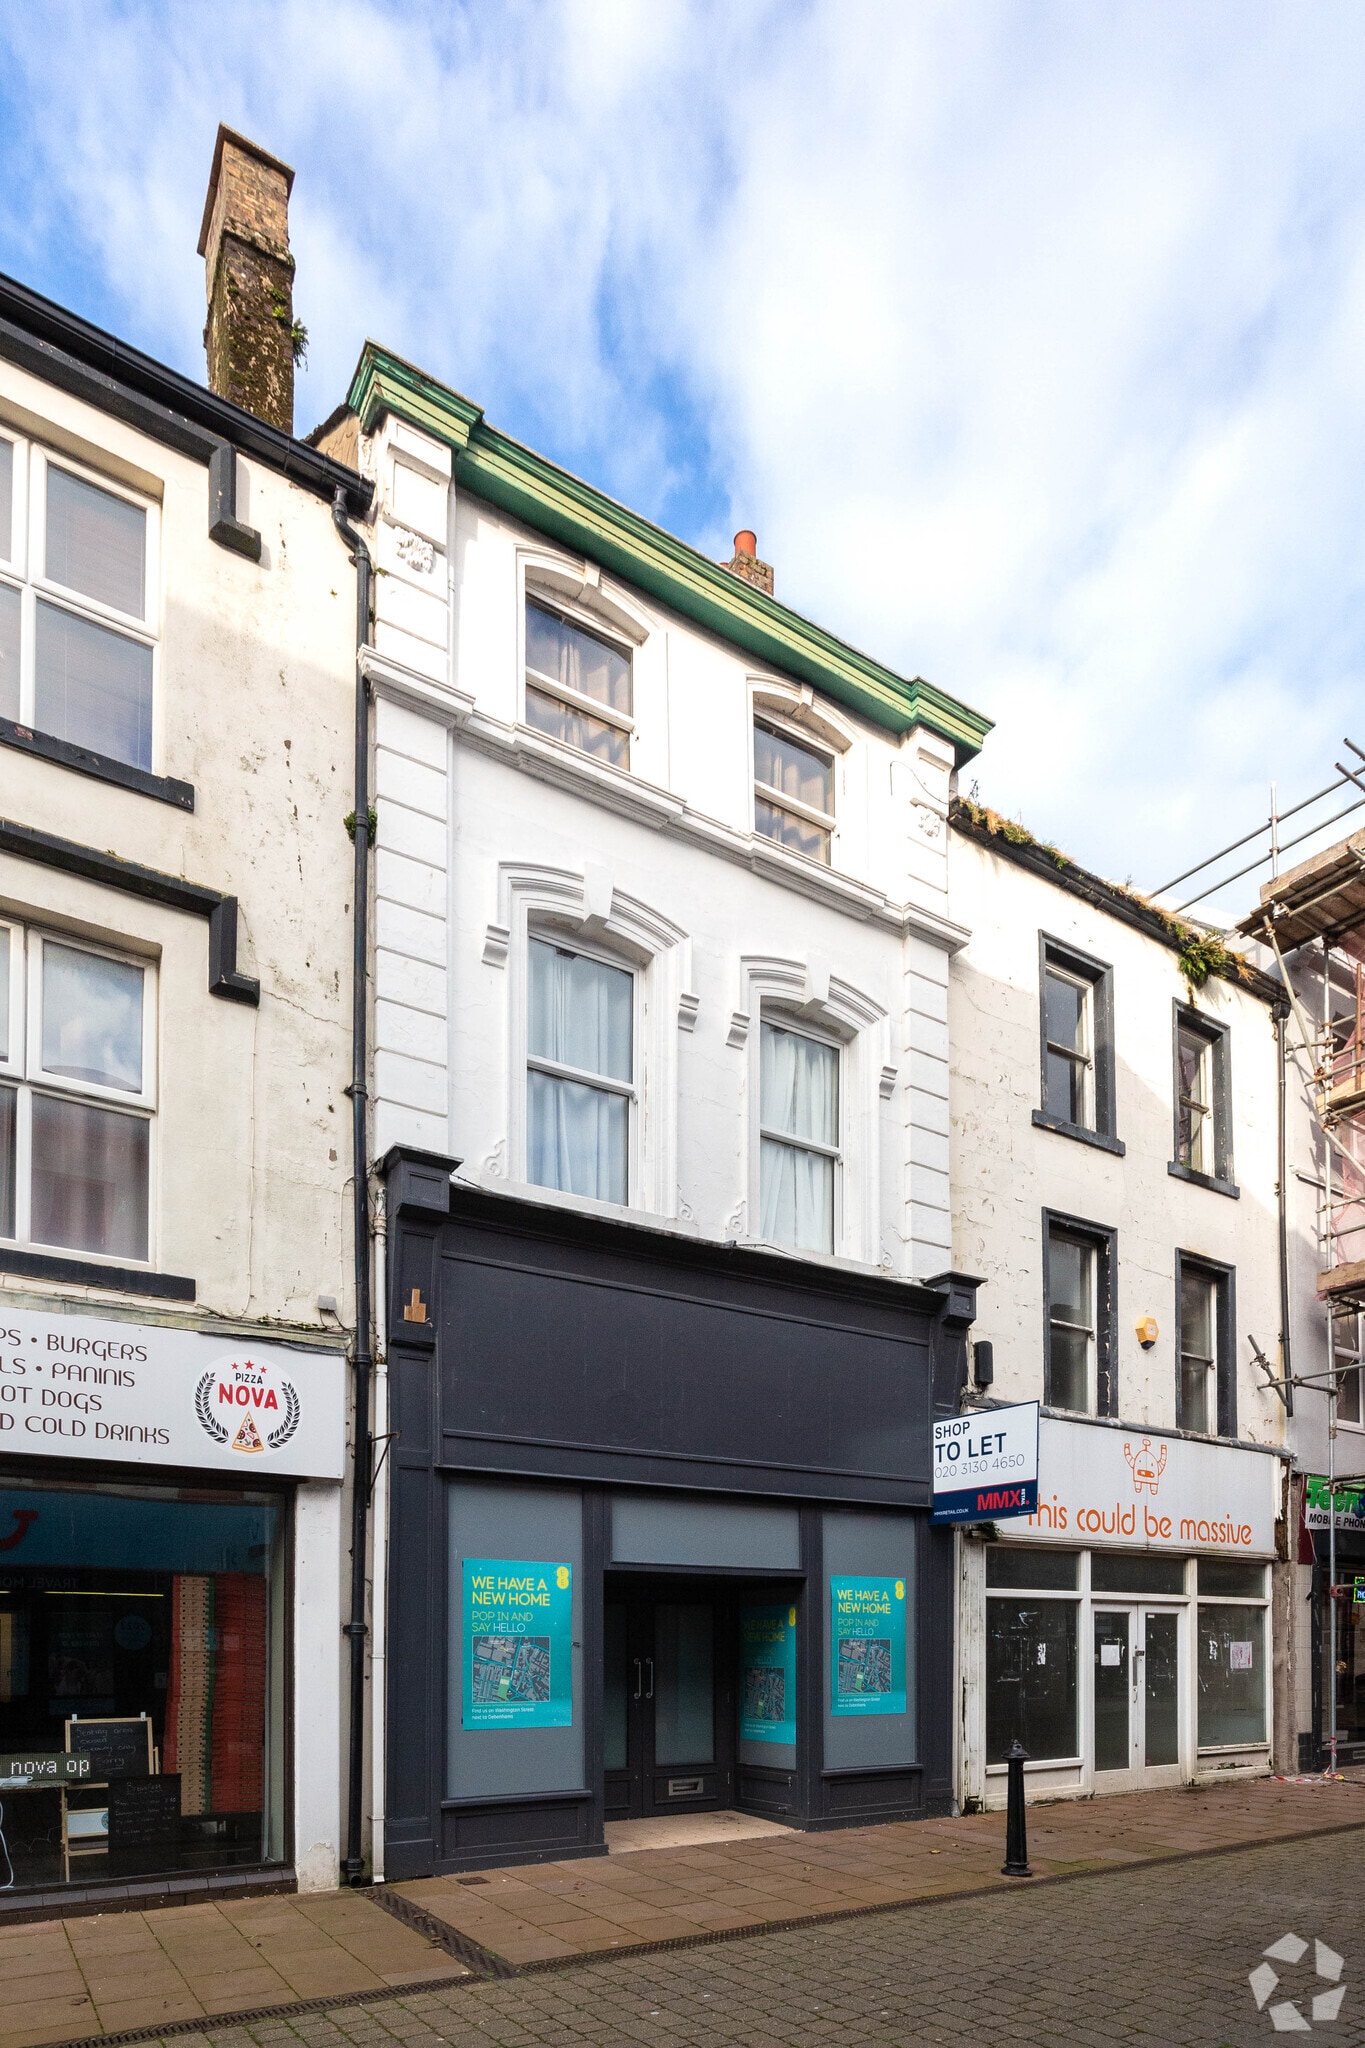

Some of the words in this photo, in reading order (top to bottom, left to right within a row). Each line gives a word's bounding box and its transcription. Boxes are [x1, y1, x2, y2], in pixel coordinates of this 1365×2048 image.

[47, 1334, 148, 1362] BURGERS
[52, 1362, 135, 1387] PANINIS
[235, 1372, 263, 1384] PIZZA
[1, 1385, 33, 1404] OT
[42, 1389, 102, 1414] DOGS
[219, 1383, 278, 1410] NOVA
[25, 1416, 86, 1437] COLD
[95, 1422, 170, 1445] DRINKS
[935, 1421, 970, 1440] SHOP
[935, 1441, 961, 1463] TO
[968, 1432, 1007, 1458] LET
[934, 1465, 957, 1479] 020
[961, 1459, 988, 1475] 3130
[992, 1453, 1025, 1469] 4650
[1028, 1493, 1068, 1530] his
[1076, 1502, 1135, 1536] could
[1144, 1505, 1172, 1539] be
[1180, 1513, 1252, 1545] massive
[472, 1576, 494, 1589] WE
[498, 1577, 535, 1591] HAVE
[537, 1579, 547, 1591] A
[472, 1592, 506, 1605] NEW
[508, 1593, 550, 1606] HOME
[837, 1589, 853, 1601] WE
[855, 1590, 880, 1602] HAVE
[881, 1591, 889, 1601] A
[472, 1611, 495, 1621] POP
[498, 1611, 509, 1621] IN
[511, 1612, 533, 1622] AND
[838, 1602, 861, 1613] NEW
[862, 1603, 891, 1614] HOME
[472, 1623, 491, 1632] SAY
[493, 1623, 526, 1633] HELLO
[838, 1618, 854, 1626] POP
[864, 1619, 879, 1627] AND
[838, 1627, 851, 1636] SAY
[852, 1627, 874, 1636] HELLO
[11, 1761, 57, 1775] nova
[66, 1759, 90, 1777] op
